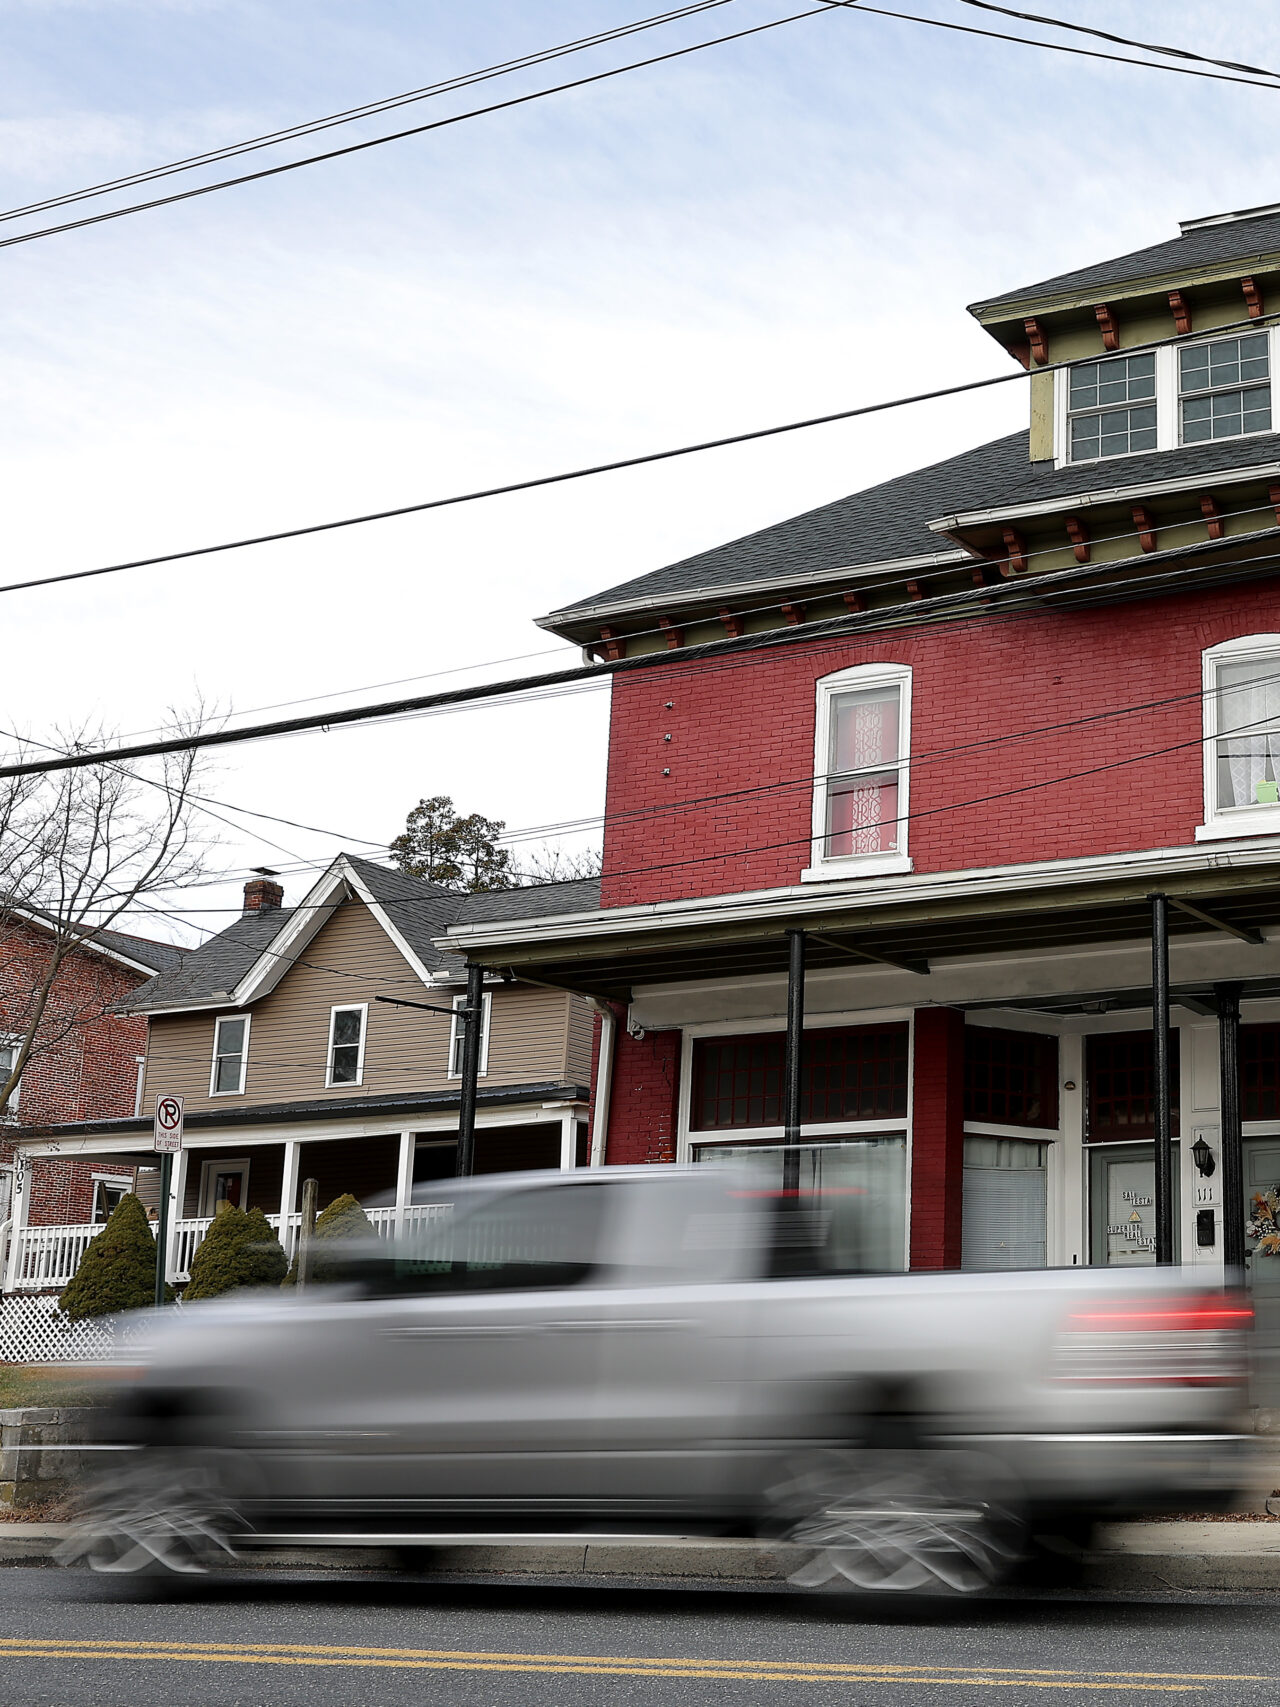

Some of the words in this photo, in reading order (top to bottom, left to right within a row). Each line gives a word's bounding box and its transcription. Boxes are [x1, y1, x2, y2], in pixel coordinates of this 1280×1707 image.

[158, 1131, 168, 1139] THIS
[169, 1132, 179, 1140] SIDE
[164, 1140, 180, 1148] STREET
[15, 1159, 24, 1195] 105
[1197, 1187, 1213, 1201] 111
[1130, 1197, 1151, 1205] TESTA
[1107, 1224, 1140, 1233] SUPERIOR
[1124, 1231, 1140, 1239] REAL
[1136, 1237, 1157, 1246] ESTAT
